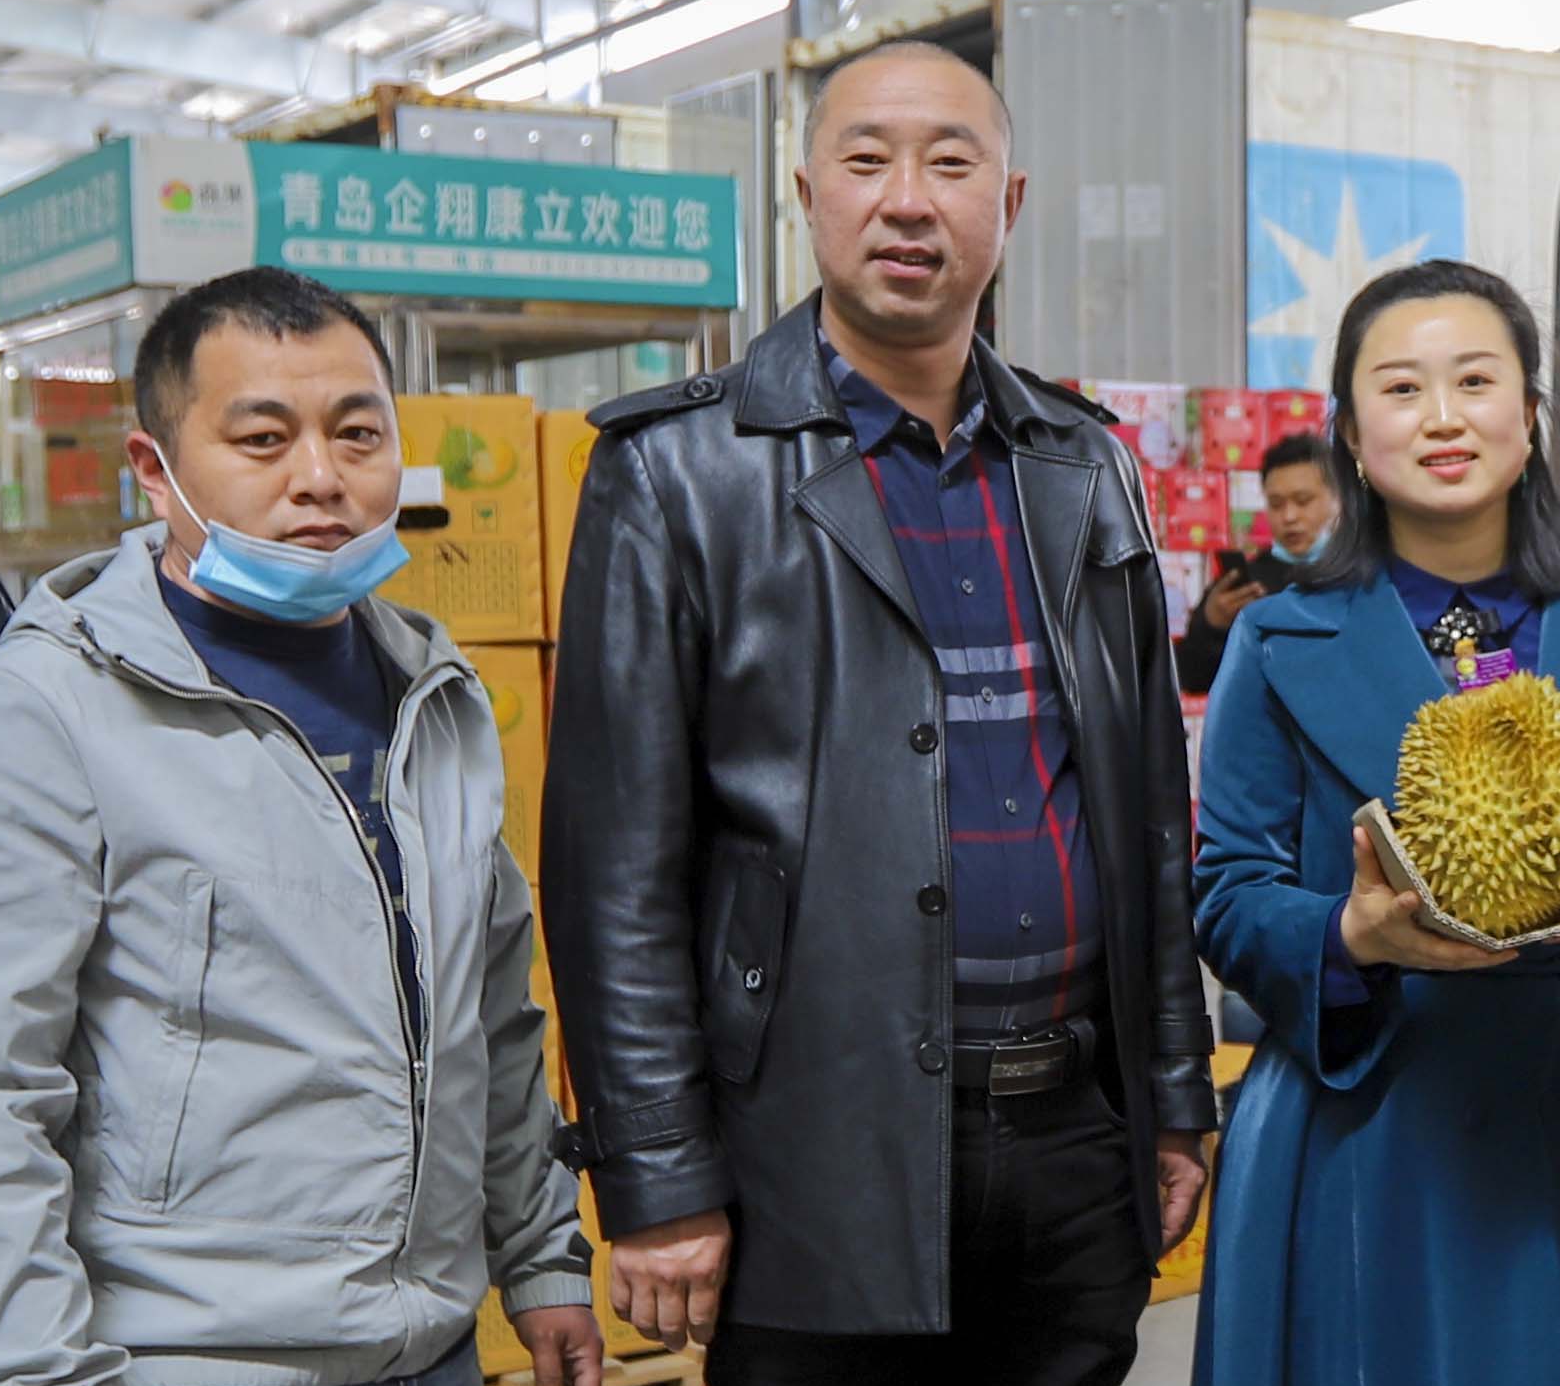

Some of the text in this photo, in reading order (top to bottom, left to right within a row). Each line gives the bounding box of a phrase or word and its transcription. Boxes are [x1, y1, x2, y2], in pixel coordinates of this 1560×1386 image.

[280, 171, 711, 251] 青岛企翔康立欢迎您
